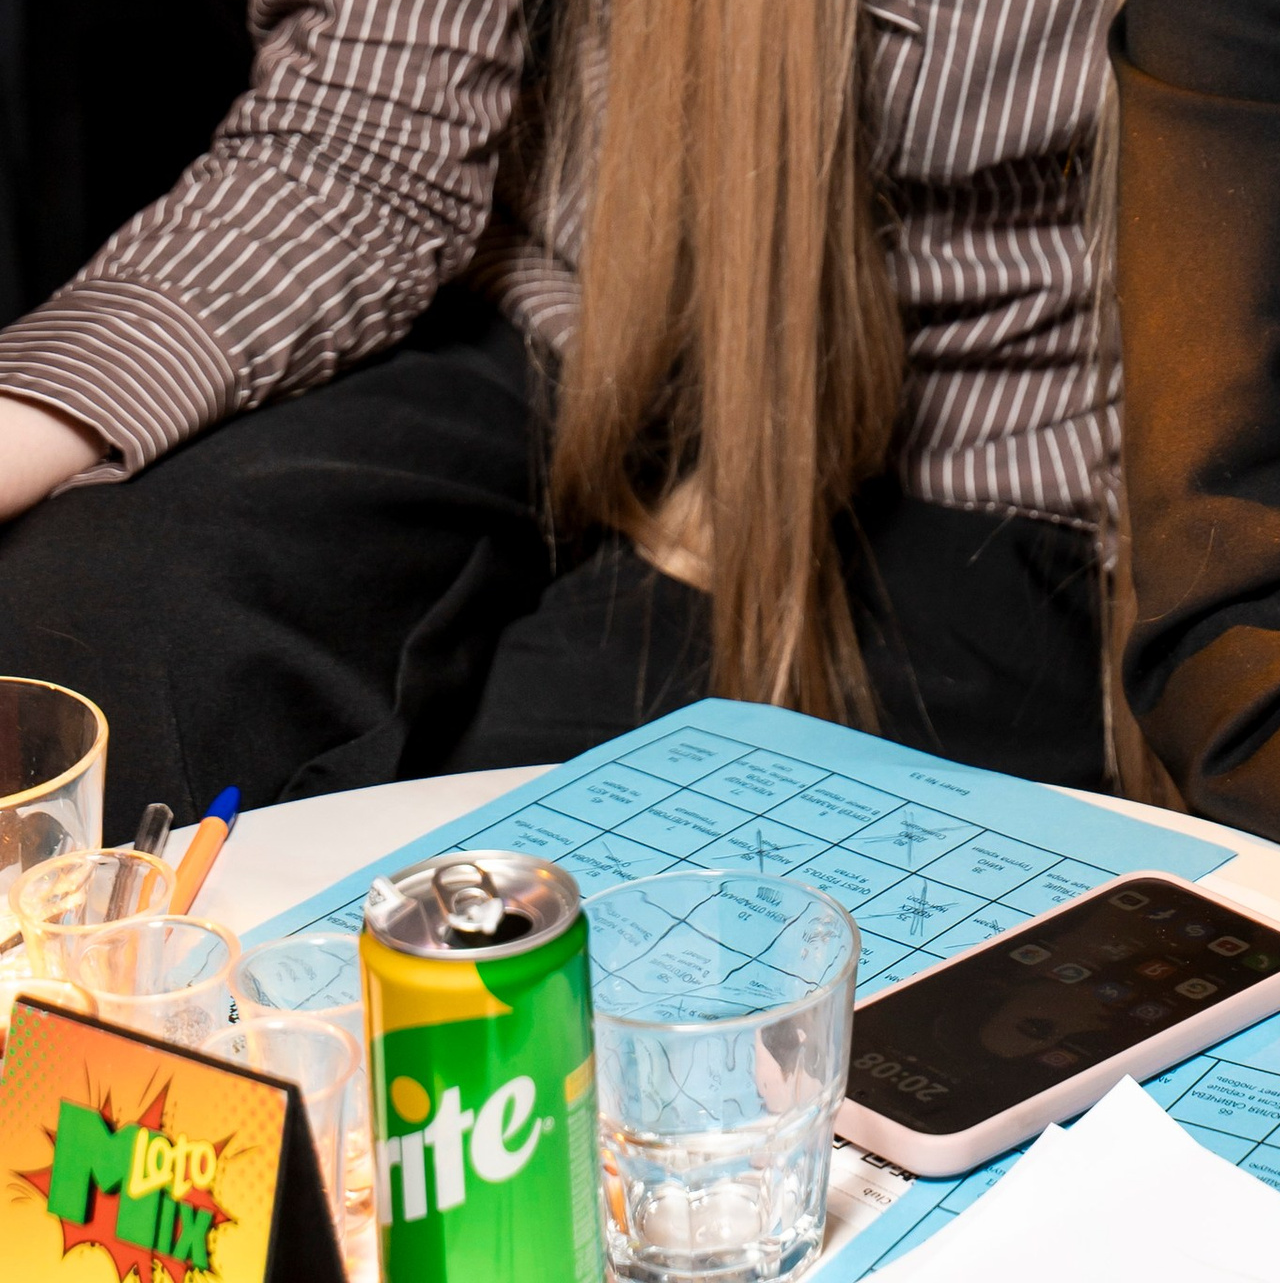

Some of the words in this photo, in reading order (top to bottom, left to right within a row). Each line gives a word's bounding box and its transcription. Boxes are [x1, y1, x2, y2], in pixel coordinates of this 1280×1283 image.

[938, 783, 970, 795] Билет
[972, 847, 1000, 858] крови
[977, 859, 1005, 871] КИНО
[1000, 857, 1033, 871] Группа
[803, 868, 841, 884] PISTOLS
[839, 882, 871, 895] QUEST
[854, 1053, 949, 1102] 20:08
[1216, 1076, 1256, 1090] любовь
[1207, 1085, 1245, 1098] сердце
[1191, 1090, 1246, 1109] САВИЧЕВА
[863, 1186, 892, 1206] Club
